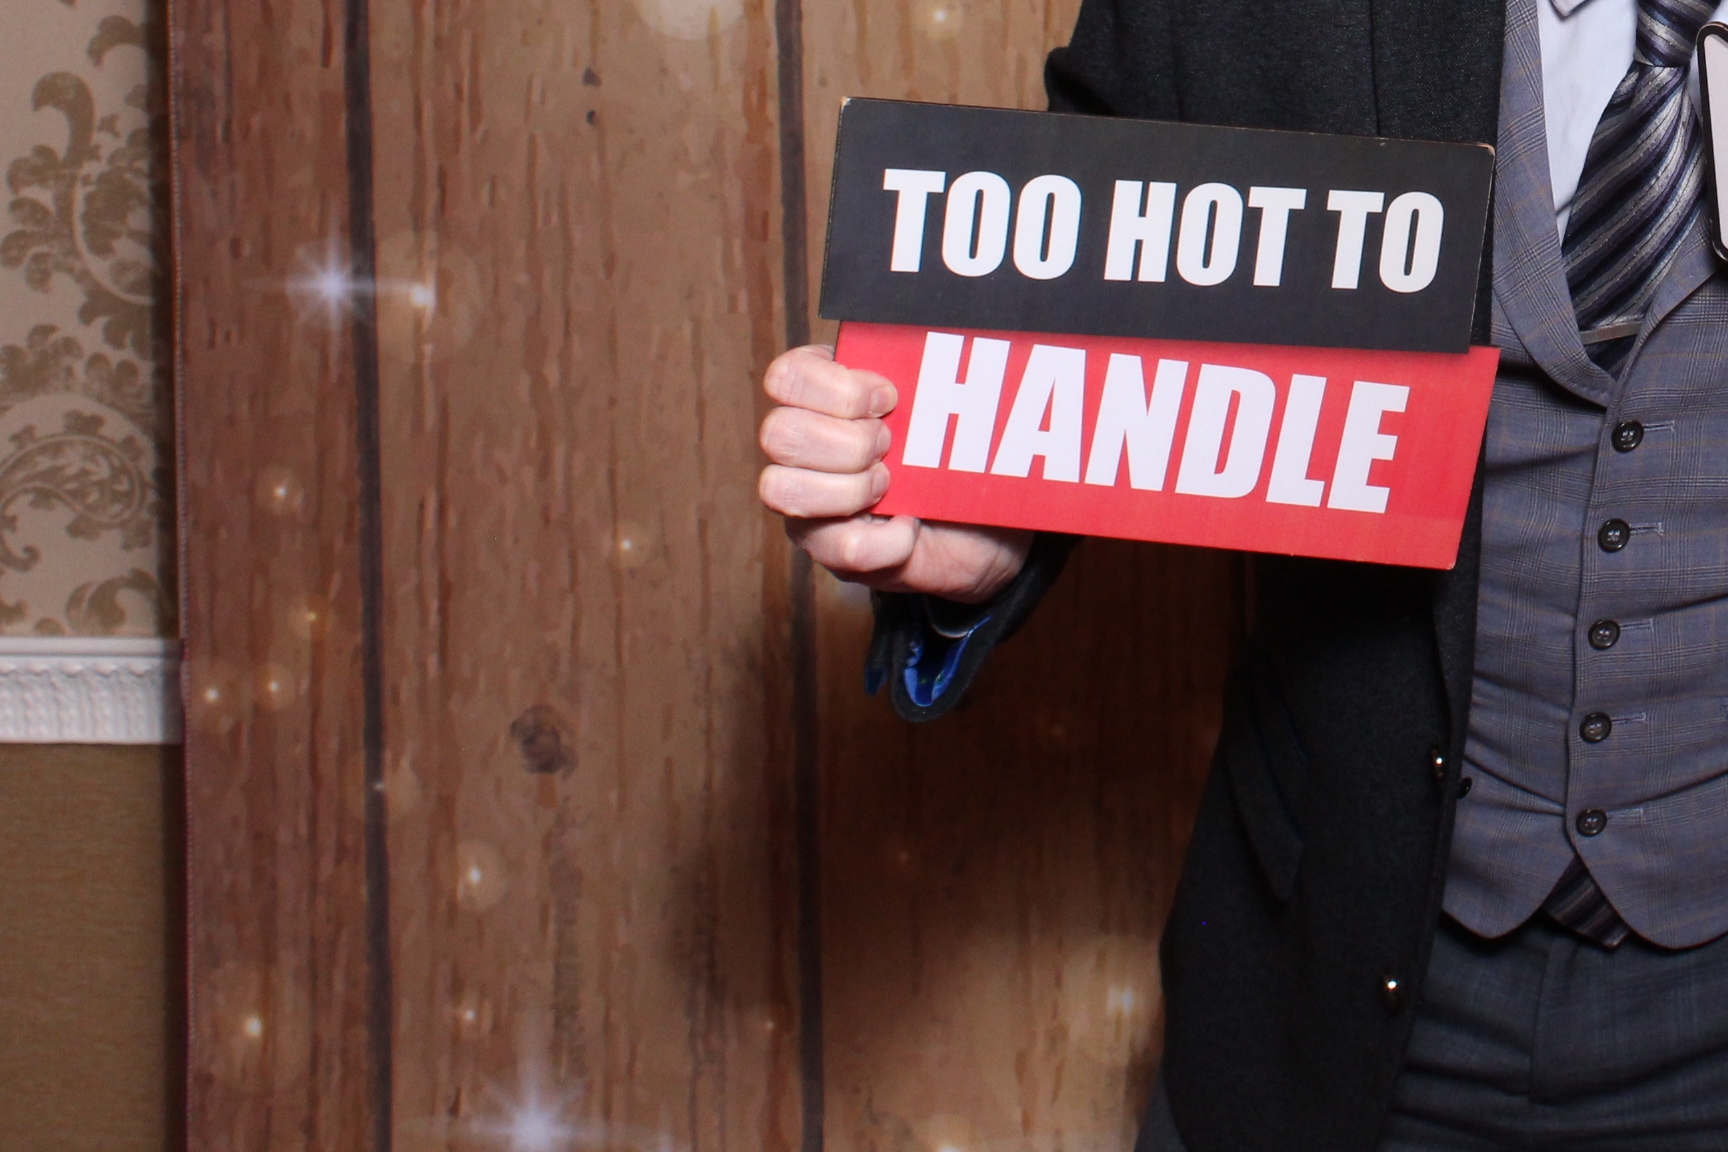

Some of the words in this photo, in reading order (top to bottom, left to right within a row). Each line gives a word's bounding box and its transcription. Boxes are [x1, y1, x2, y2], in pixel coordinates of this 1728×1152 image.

[883, 168, 1082, 280] TOO
[1104, 179, 1307, 287] HOT
[1327, 190, 1444, 294] TO
[901, 330, 1411, 515] HANDLE
